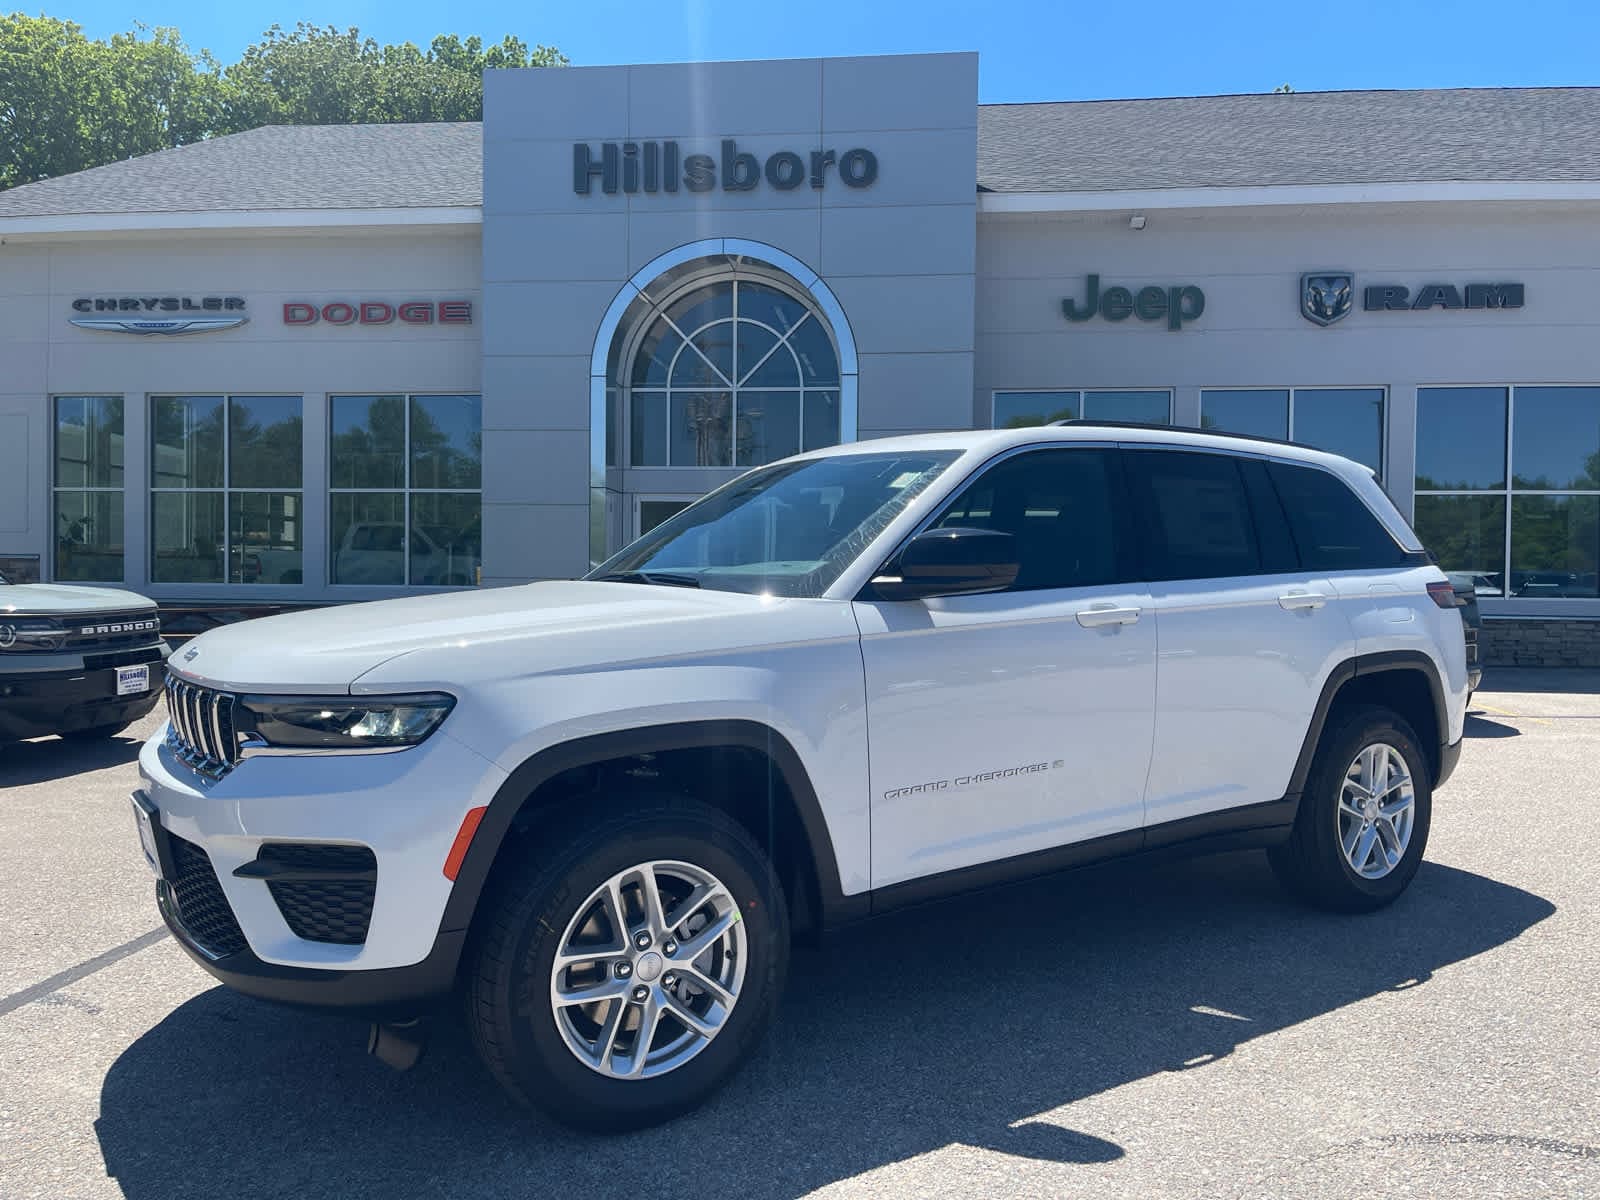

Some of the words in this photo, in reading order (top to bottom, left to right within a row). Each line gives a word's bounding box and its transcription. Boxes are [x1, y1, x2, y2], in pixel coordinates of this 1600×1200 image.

[573, 139, 879, 194] Hillsboro
[71, 296, 247, 313] CHRYSLER
[1061, 274, 1206, 331] Jeep
[1363, 282, 1525, 312] RAM
[282, 301, 473, 326] DODGE
[81, 622, 154, 635] BRONCO
[884, 780, 949, 801] GRAND
[954, 762, 1049, 786] CHEROKEE
